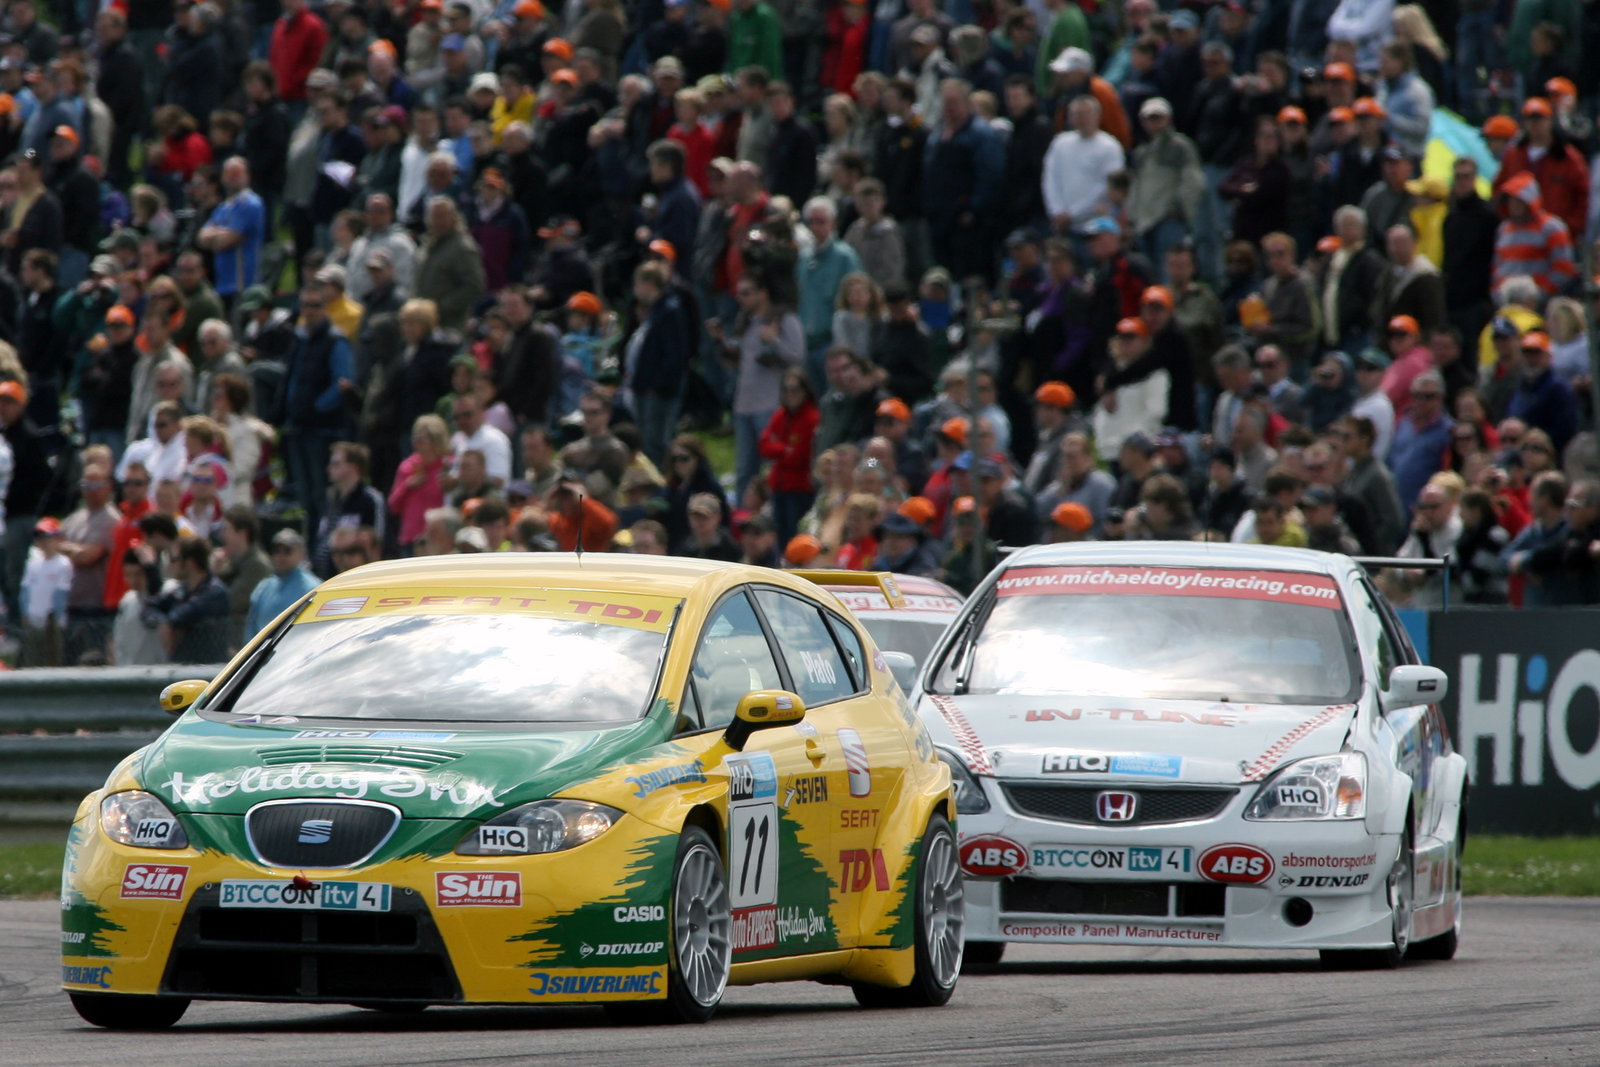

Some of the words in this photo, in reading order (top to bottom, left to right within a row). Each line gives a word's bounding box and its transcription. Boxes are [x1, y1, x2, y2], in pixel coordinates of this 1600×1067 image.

[996, 571, 1337, 600] www.michaeldoyleracing.com
[375, 596, 548, 608] SEAT
[568, 600, 663, 624] TDI
[801, 651, 836, 685] Plato
[1043, 754, 1107, 771] HiQ
[161, 764, 368, 806] Holiday
[380, 767, 504, 807] Inn
[730, 765, 754, 795] HiQ
[795, 776, 828, 804] SEVEN
[1280, 788, 1319, 804] HiQ
[840, 808, 879, 828] SEAT
[136, 821, 169, 839] HiQ
[482, 829, 526, 848] HiQ
[740, 814, 769, 897] 11
[966, 848, 1019, 867] ABS
[1131, 849, 1160, 868] itv
[1166, 851, 1180, 870] 4
[1281, 852, 1377, 872] absmotorsport.net
[839, 848, 890, 893] TDI
[1211, 856, 1266, 877] ABS
[124, 867, 183, 891] Sun
[439, 874, 517, 898] Sun
[1297, 873, 1369, 888] DUNLOP
[324, 886, 355, 904] itv
[361, 886, 376, 907] 4
[613, 906, 665, 923] CASIO
[776, 905, 809, 943] Holiday
[809, 907, 827, 937] Inn
[747, 908, 776, 947] EXPRESS
[1003, 924, 1077, 938] Composite
[1081, 924, 1120, 937] Panel
[1125, 925, 1221, 942] Manufacturer
[596, 942, 665, 955] DUNLOP
